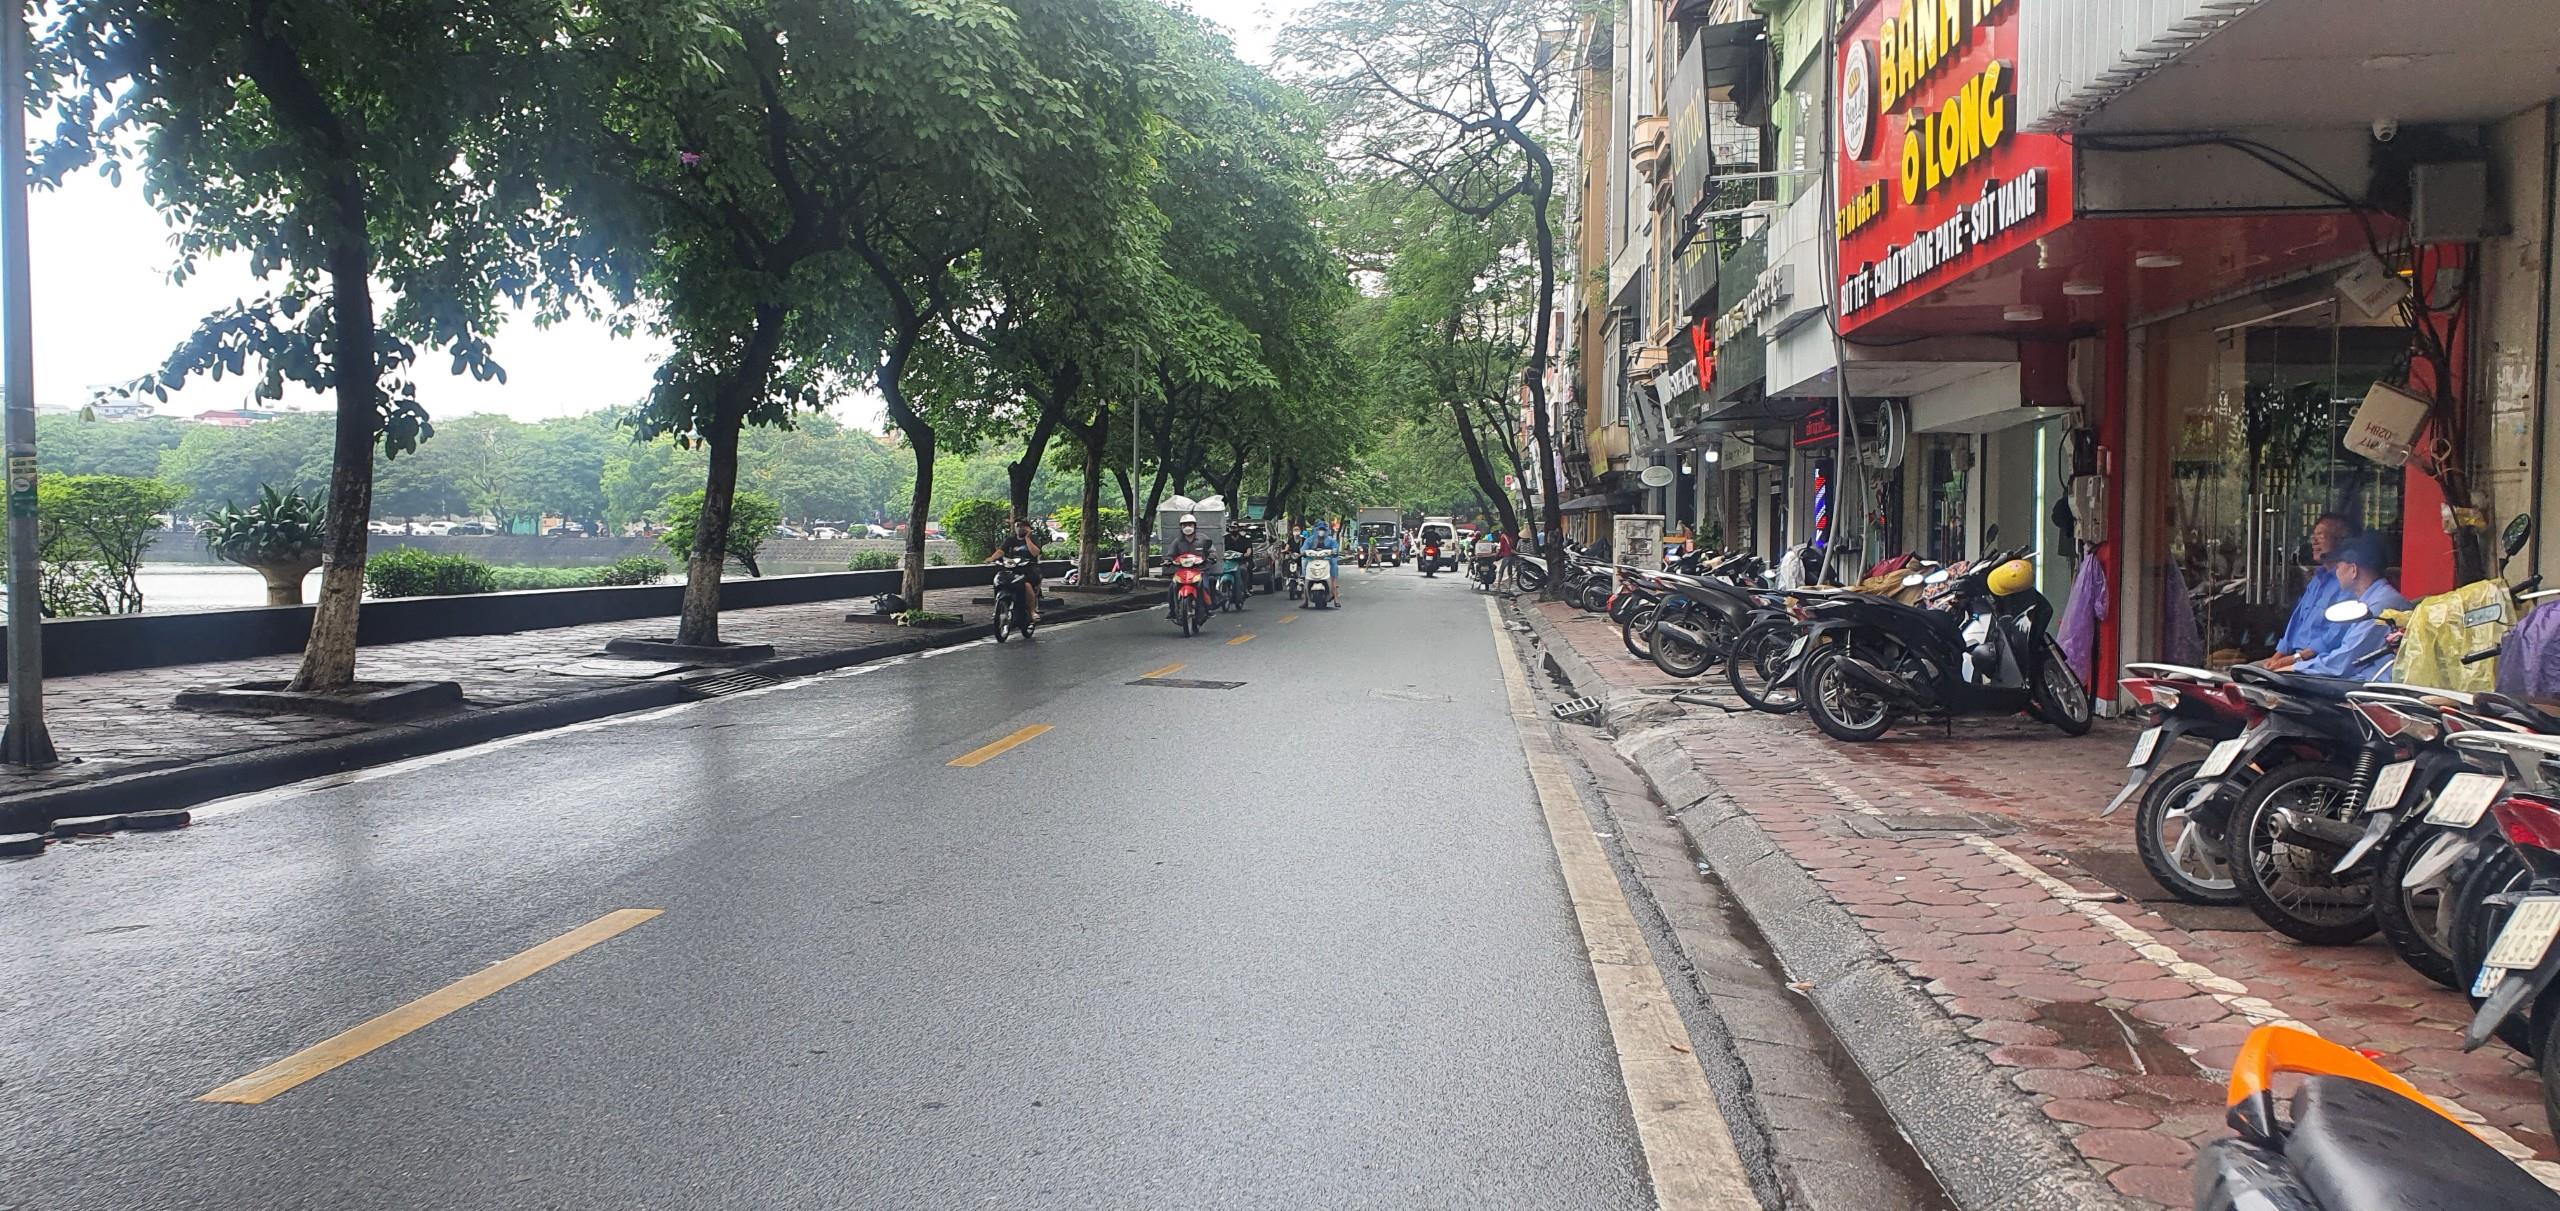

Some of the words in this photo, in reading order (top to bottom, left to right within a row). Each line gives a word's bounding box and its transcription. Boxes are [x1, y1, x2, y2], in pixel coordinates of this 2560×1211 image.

[1901, 108, 1920, 206] Ô
[1925, 60, 2004, 192] LONG
[1854, 262, 1869, 310] TẾT
[1874, 245, 1899, 298] CHẢO
[1900, 231, 1934, 285] TRỨNG
[1971, 179, 1996, 245] SỐT
[1997, 168, 2036, 231] VANG
